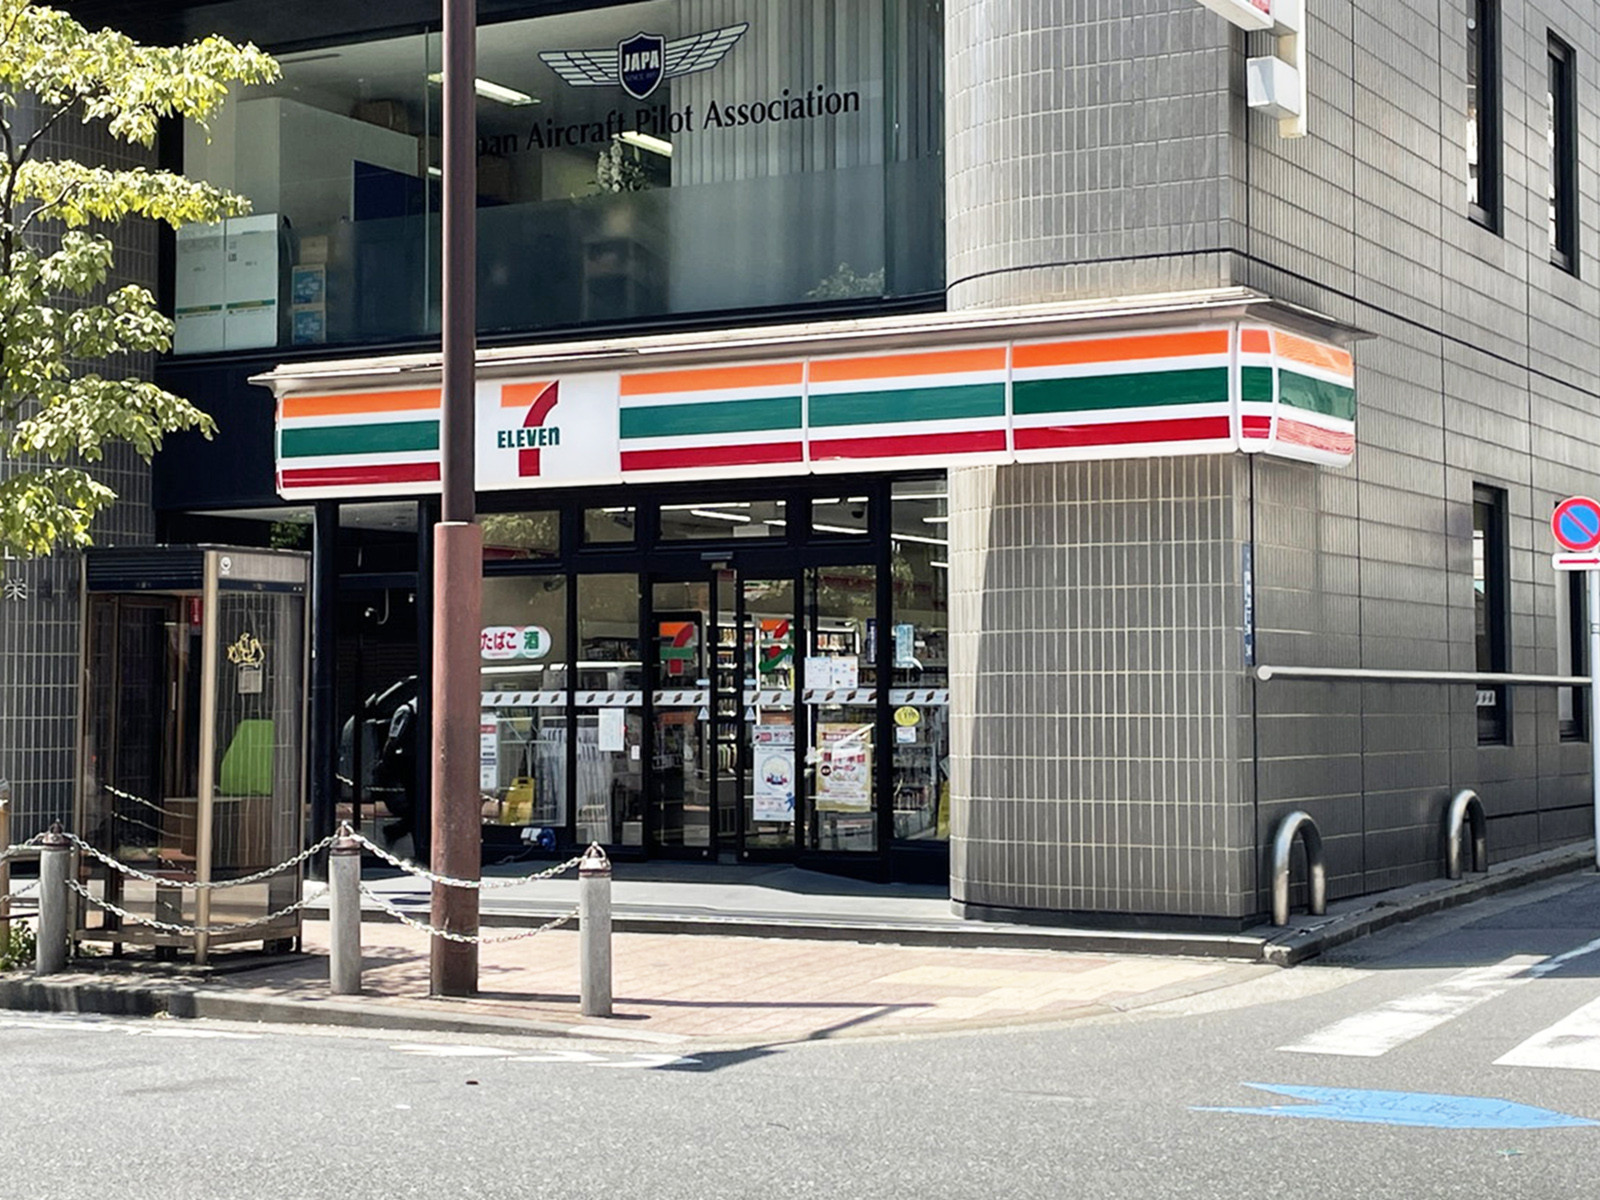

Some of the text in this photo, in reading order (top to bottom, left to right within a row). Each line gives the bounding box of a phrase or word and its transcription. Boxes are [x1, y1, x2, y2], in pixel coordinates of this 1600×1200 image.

[623, 49, 660, 73] JAPA
[476, 84, 860, 158] pan Aircraft Pilot Association
[481, 631, 540, 651] たばこ 酒
